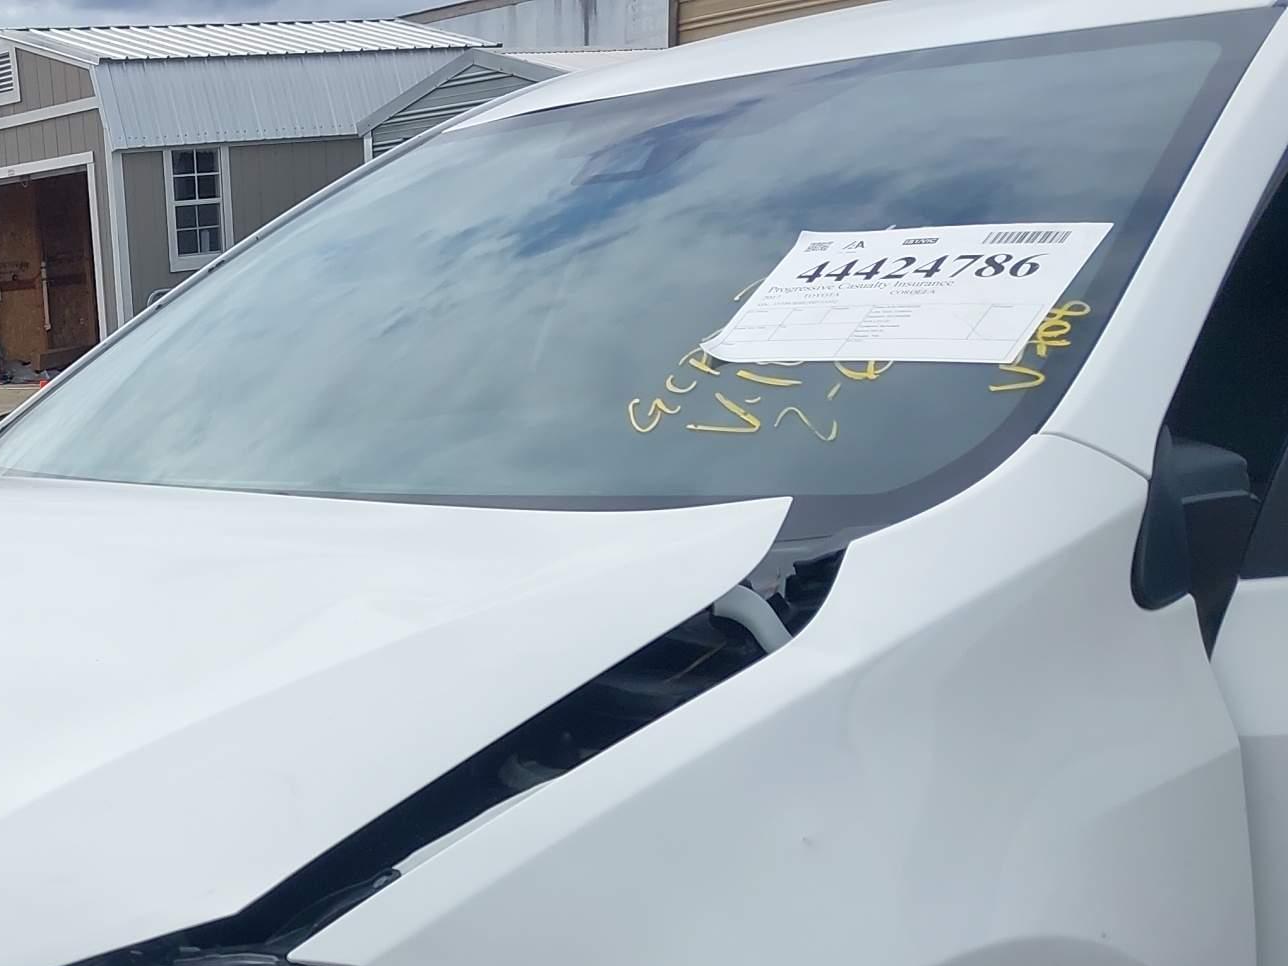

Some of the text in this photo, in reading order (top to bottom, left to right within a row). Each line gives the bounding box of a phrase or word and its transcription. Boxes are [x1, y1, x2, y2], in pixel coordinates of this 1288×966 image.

[796, 253, 1049, 284] 44424786
[767, 279, 955, 294] Progressive Casualty Insurance
